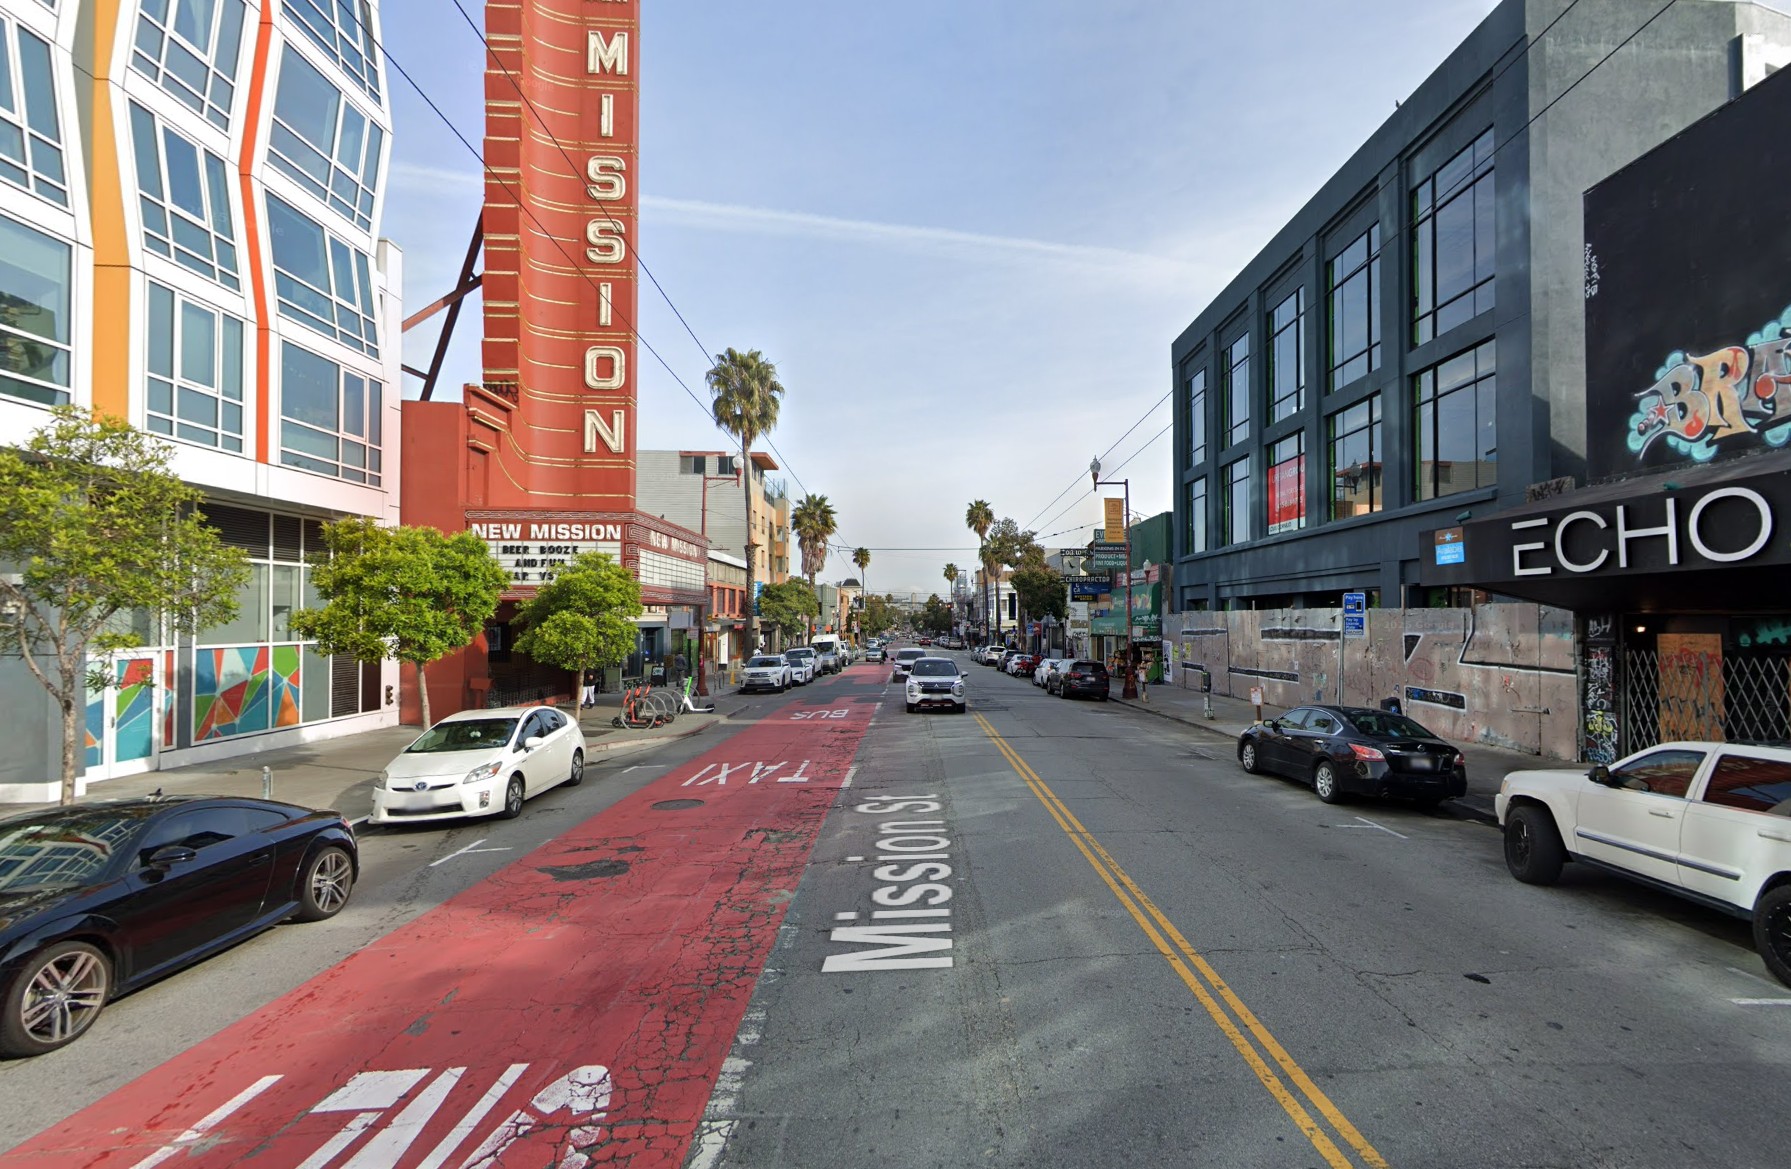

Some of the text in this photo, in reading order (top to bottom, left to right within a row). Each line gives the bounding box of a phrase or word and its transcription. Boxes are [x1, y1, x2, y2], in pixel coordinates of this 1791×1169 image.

[583, 29, 628, 454] MISSION
[471, 523, 622, 540] NEW MISSION
[650, 530, 670, 550] NEW
[1511, 486, 1773, 576] ECHO
[502, 545, 579, 555] BEER BOOZE
[514, 558, 538, 568] AND
[789, 708, 850, 719] BUS
[680, 759, 811, 787] TAXI
